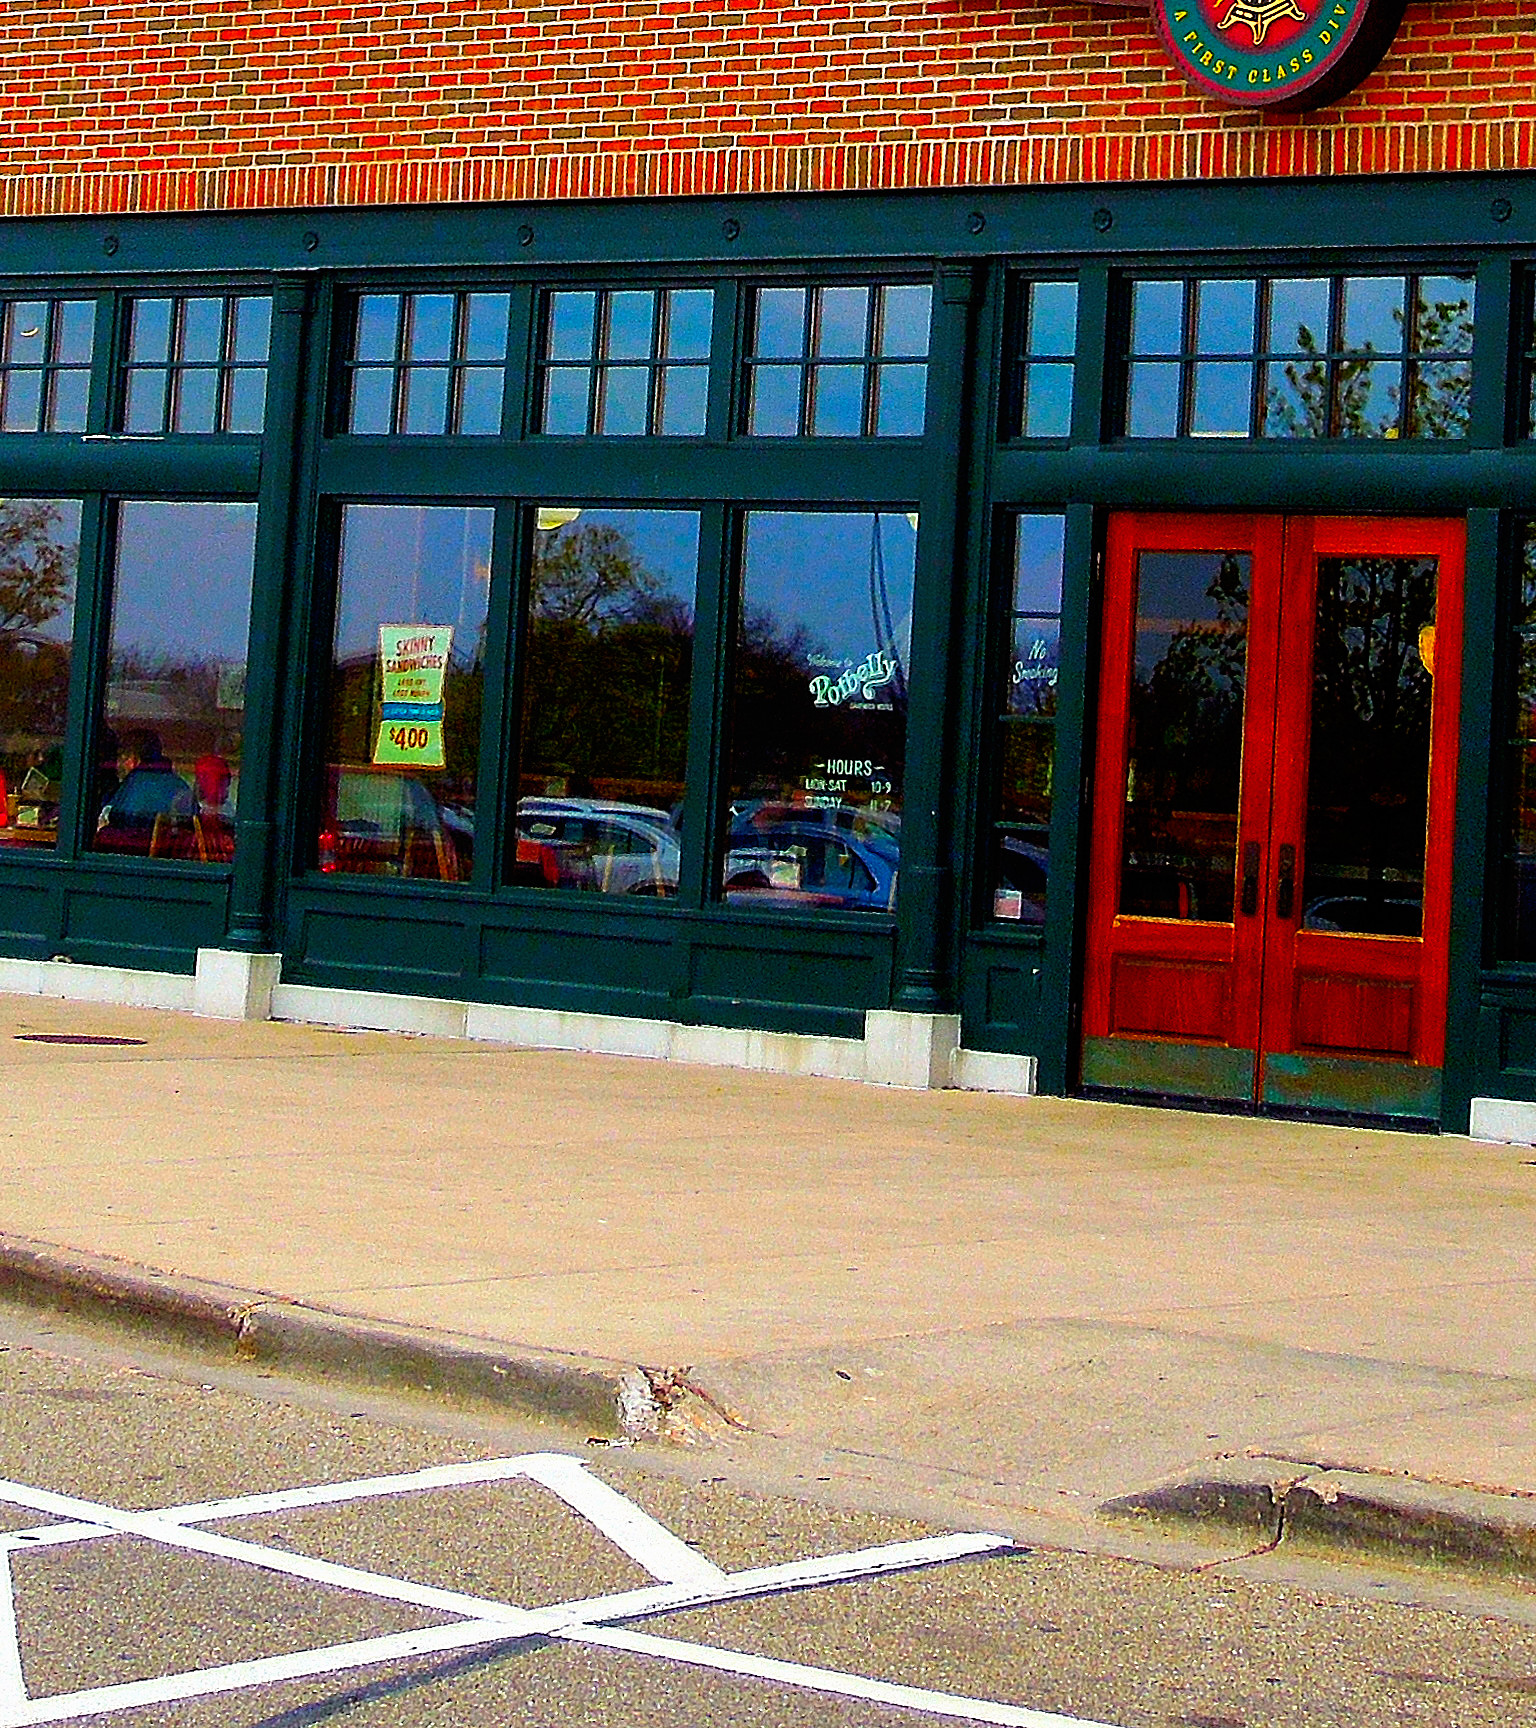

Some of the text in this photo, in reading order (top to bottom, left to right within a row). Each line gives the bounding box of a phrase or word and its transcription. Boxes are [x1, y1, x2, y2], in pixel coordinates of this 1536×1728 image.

[1173, 9, 1189, 22] A
[1183, 31, 1238, 81] FIRST
[1248, 48, 1315, 83] CLASS
[1028, 639, 1047, 660] No
[809, 650, 896, 708] Potbelly
